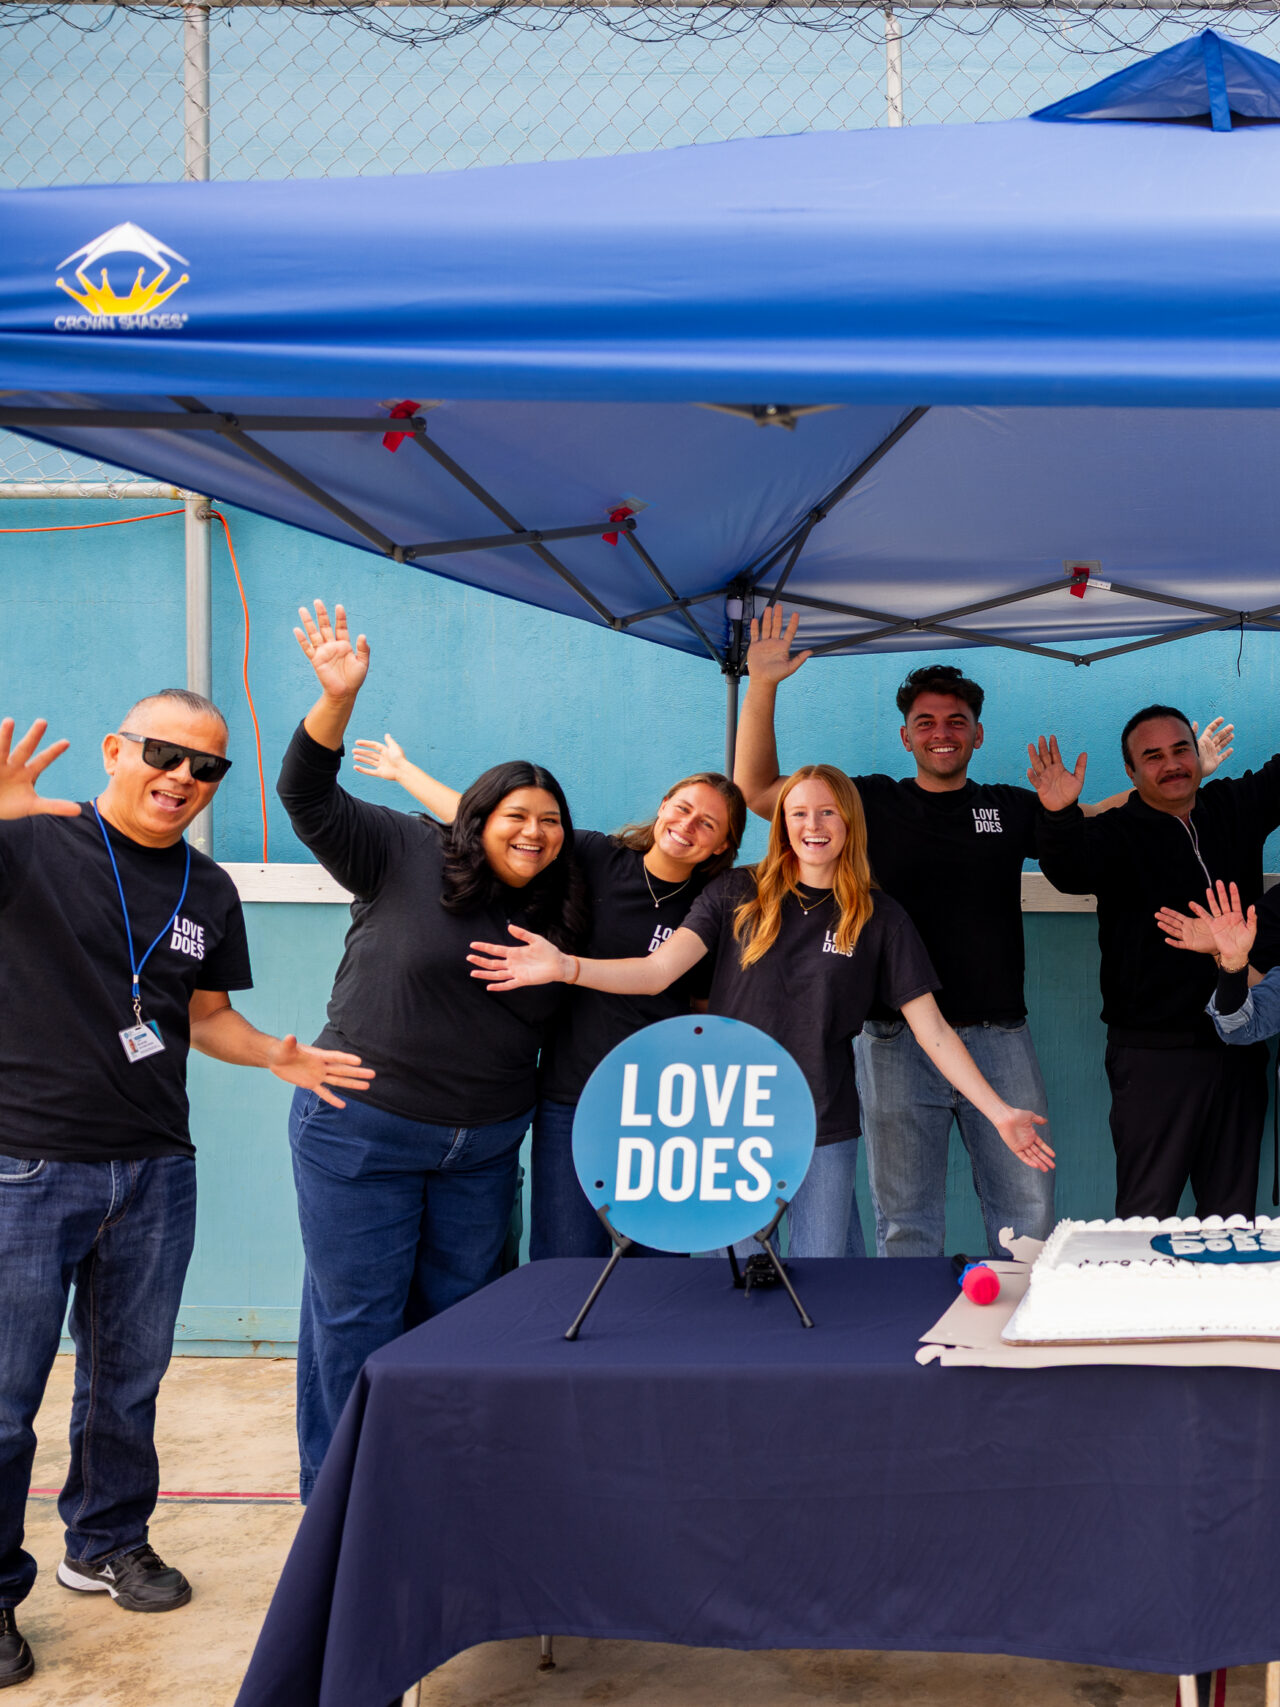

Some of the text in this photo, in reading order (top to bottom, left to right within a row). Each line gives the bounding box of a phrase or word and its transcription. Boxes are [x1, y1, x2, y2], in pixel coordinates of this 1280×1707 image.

[54, 315, 116, 331] CROWN
[971, 808, 1001, 821] LOVE
[974, 820, 1003, 833] DOES
[173, 914, 205, 944] LOVE
[653, 924, 677, 941] LO
[170, 931, 206, 961] DOES
[620, 1062, 778, 1129] LOVE
[614, 1136, 774, 1203] DOES
